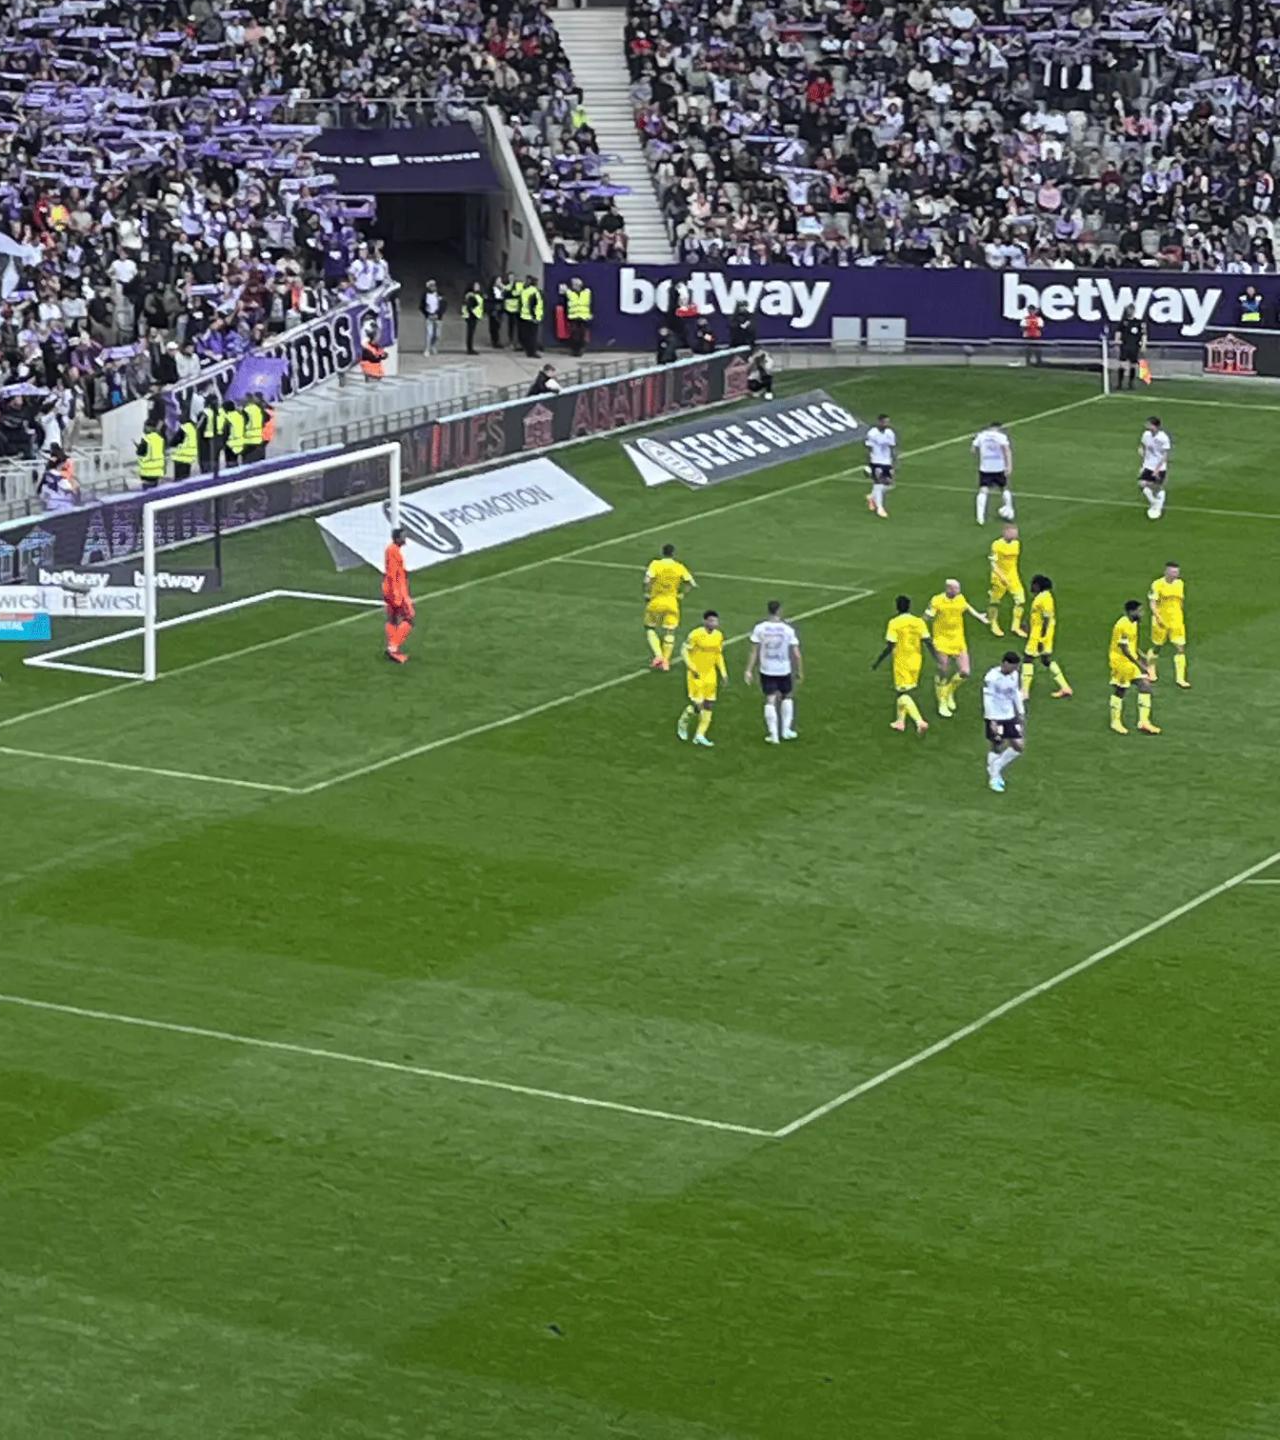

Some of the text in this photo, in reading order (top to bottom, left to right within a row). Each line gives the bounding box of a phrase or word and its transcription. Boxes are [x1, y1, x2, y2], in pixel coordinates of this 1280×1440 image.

[1002, 272, 1221, 336] betway
[745, 401, 859, 449] BLANCO
[438, 483, 555, 529] PROMOTION
